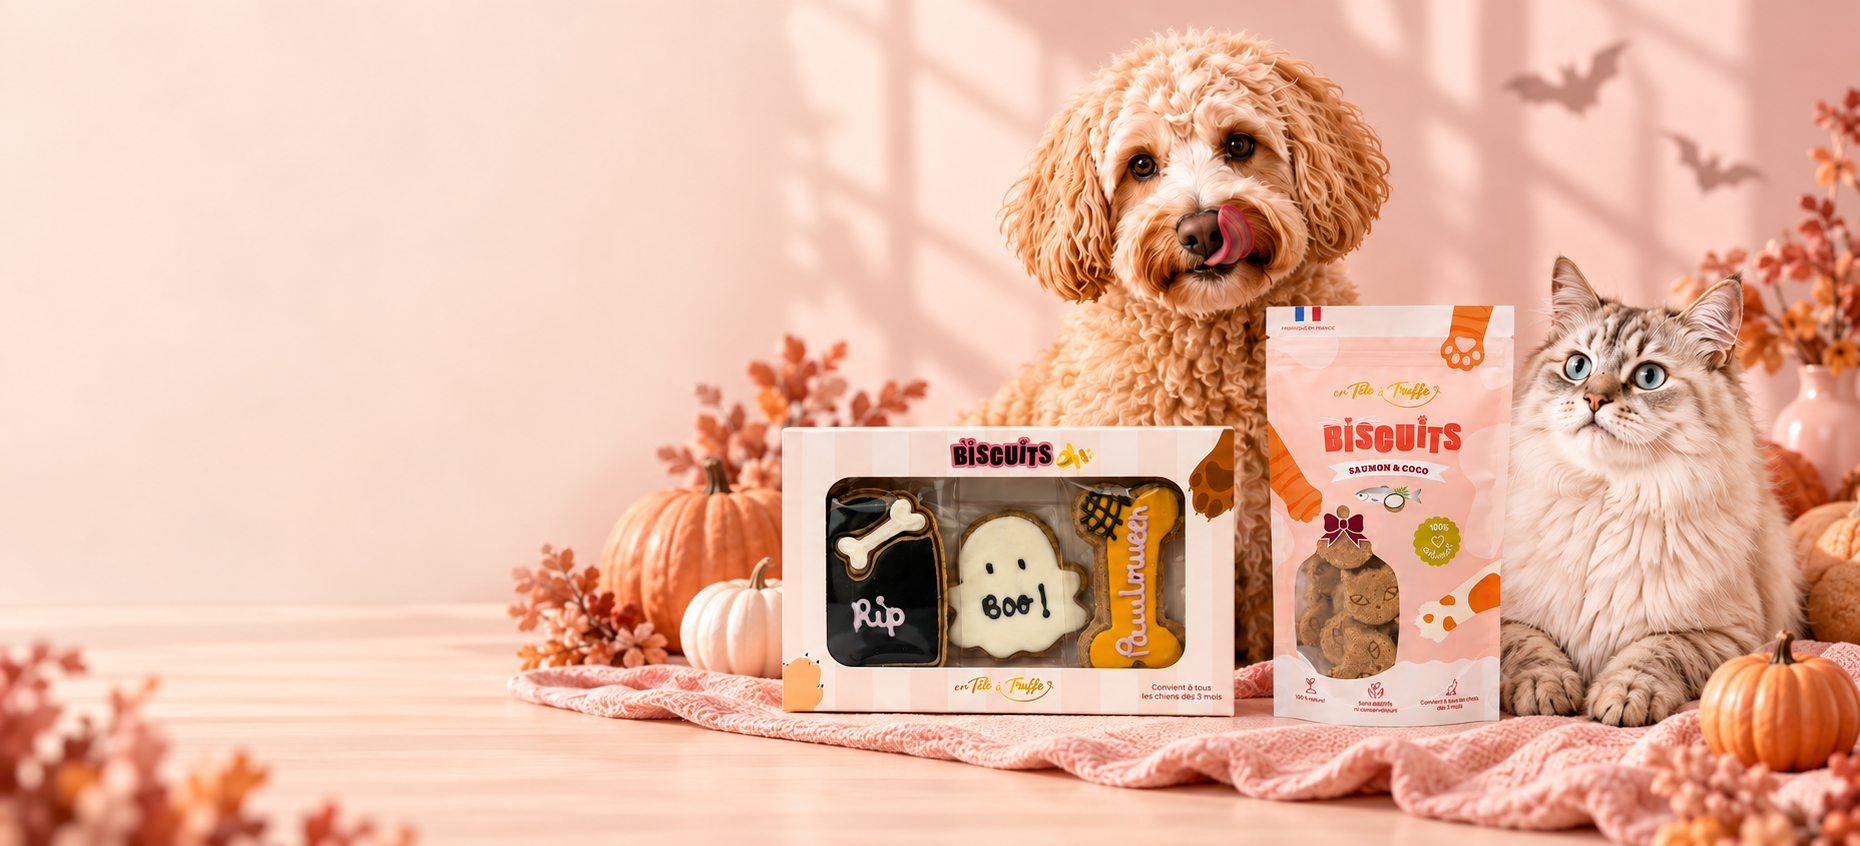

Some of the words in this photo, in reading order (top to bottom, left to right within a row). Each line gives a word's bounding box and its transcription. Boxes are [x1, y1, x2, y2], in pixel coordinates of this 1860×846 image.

[1387, 381, 1431, 400] Truffe
[1348, 464, 1391, 475] SAUMON
[1392, 464, 1400, 472] &
[1402, 465, 1429, 475] COCO
[1005, 677, 1045, 695] Truffe
